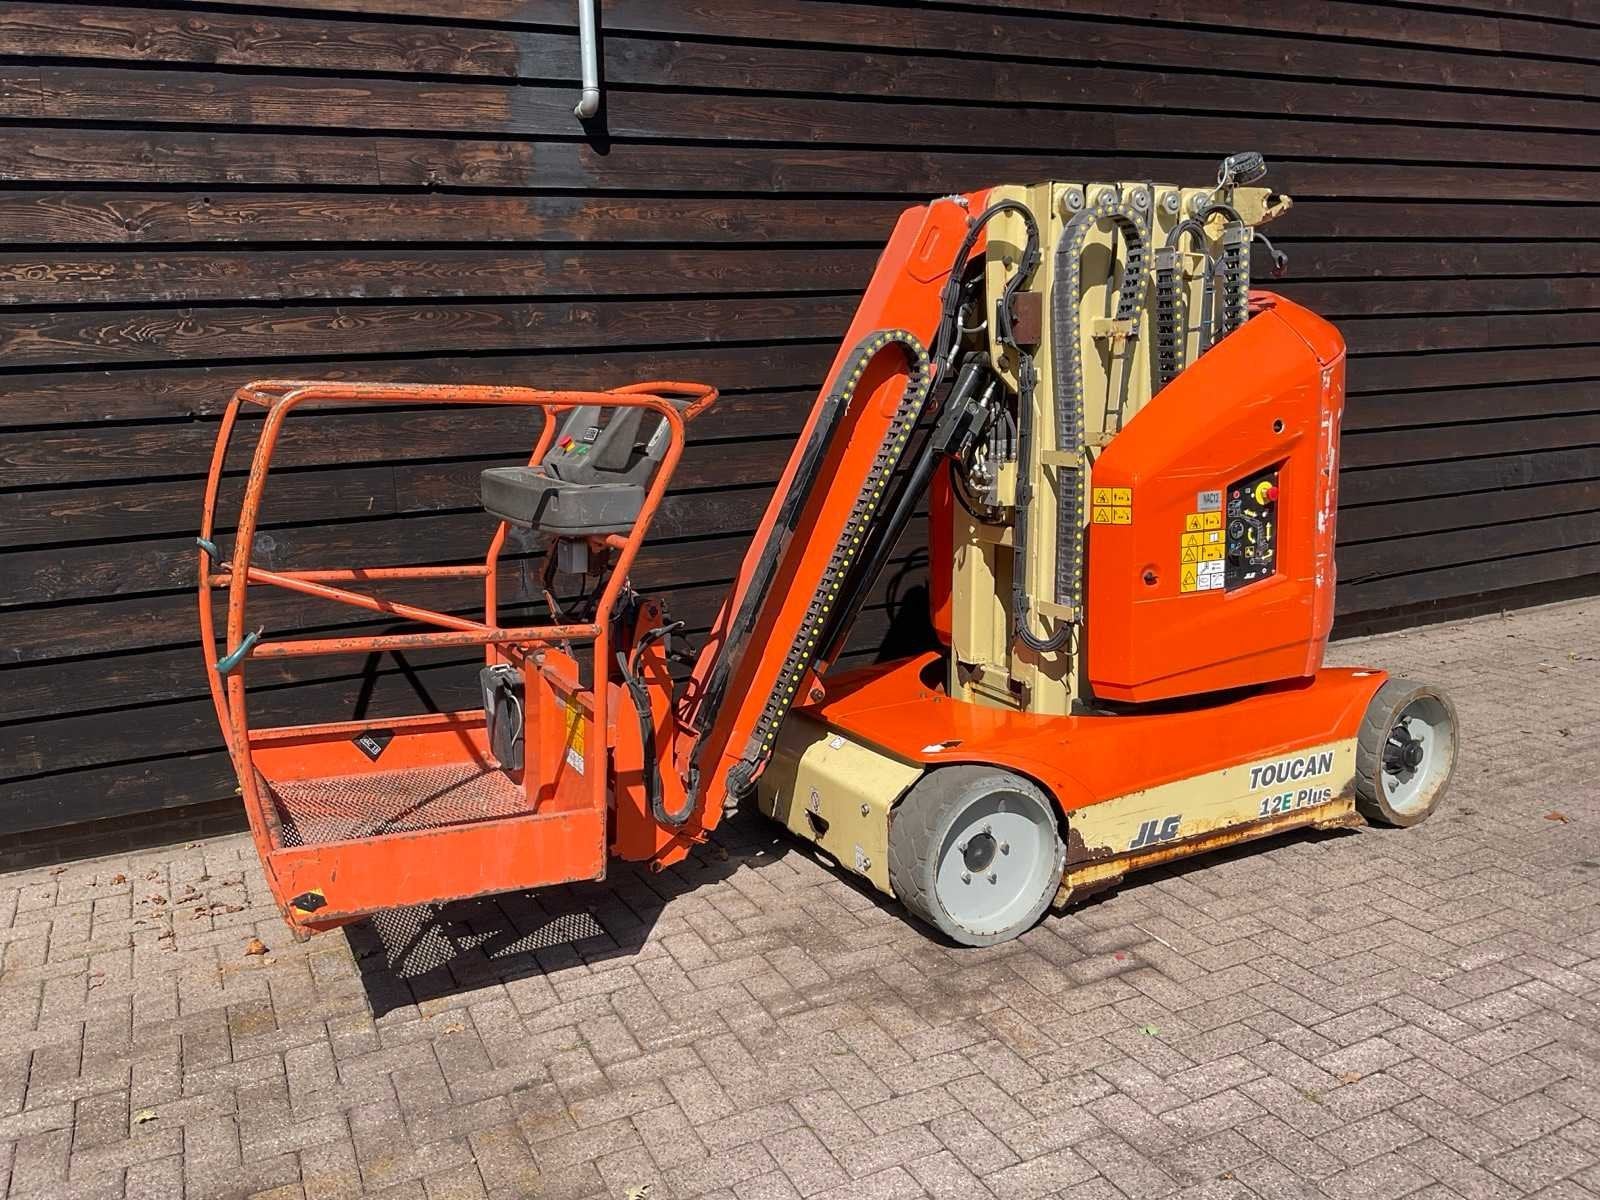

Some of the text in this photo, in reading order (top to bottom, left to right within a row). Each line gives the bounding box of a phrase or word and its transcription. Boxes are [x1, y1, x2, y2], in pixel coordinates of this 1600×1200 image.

[1250, 751, 1334, 790] TOUCAN
[1259, 788, 1332, 816] 12E Plus
[1129, 814, 1182, 849] JLG
